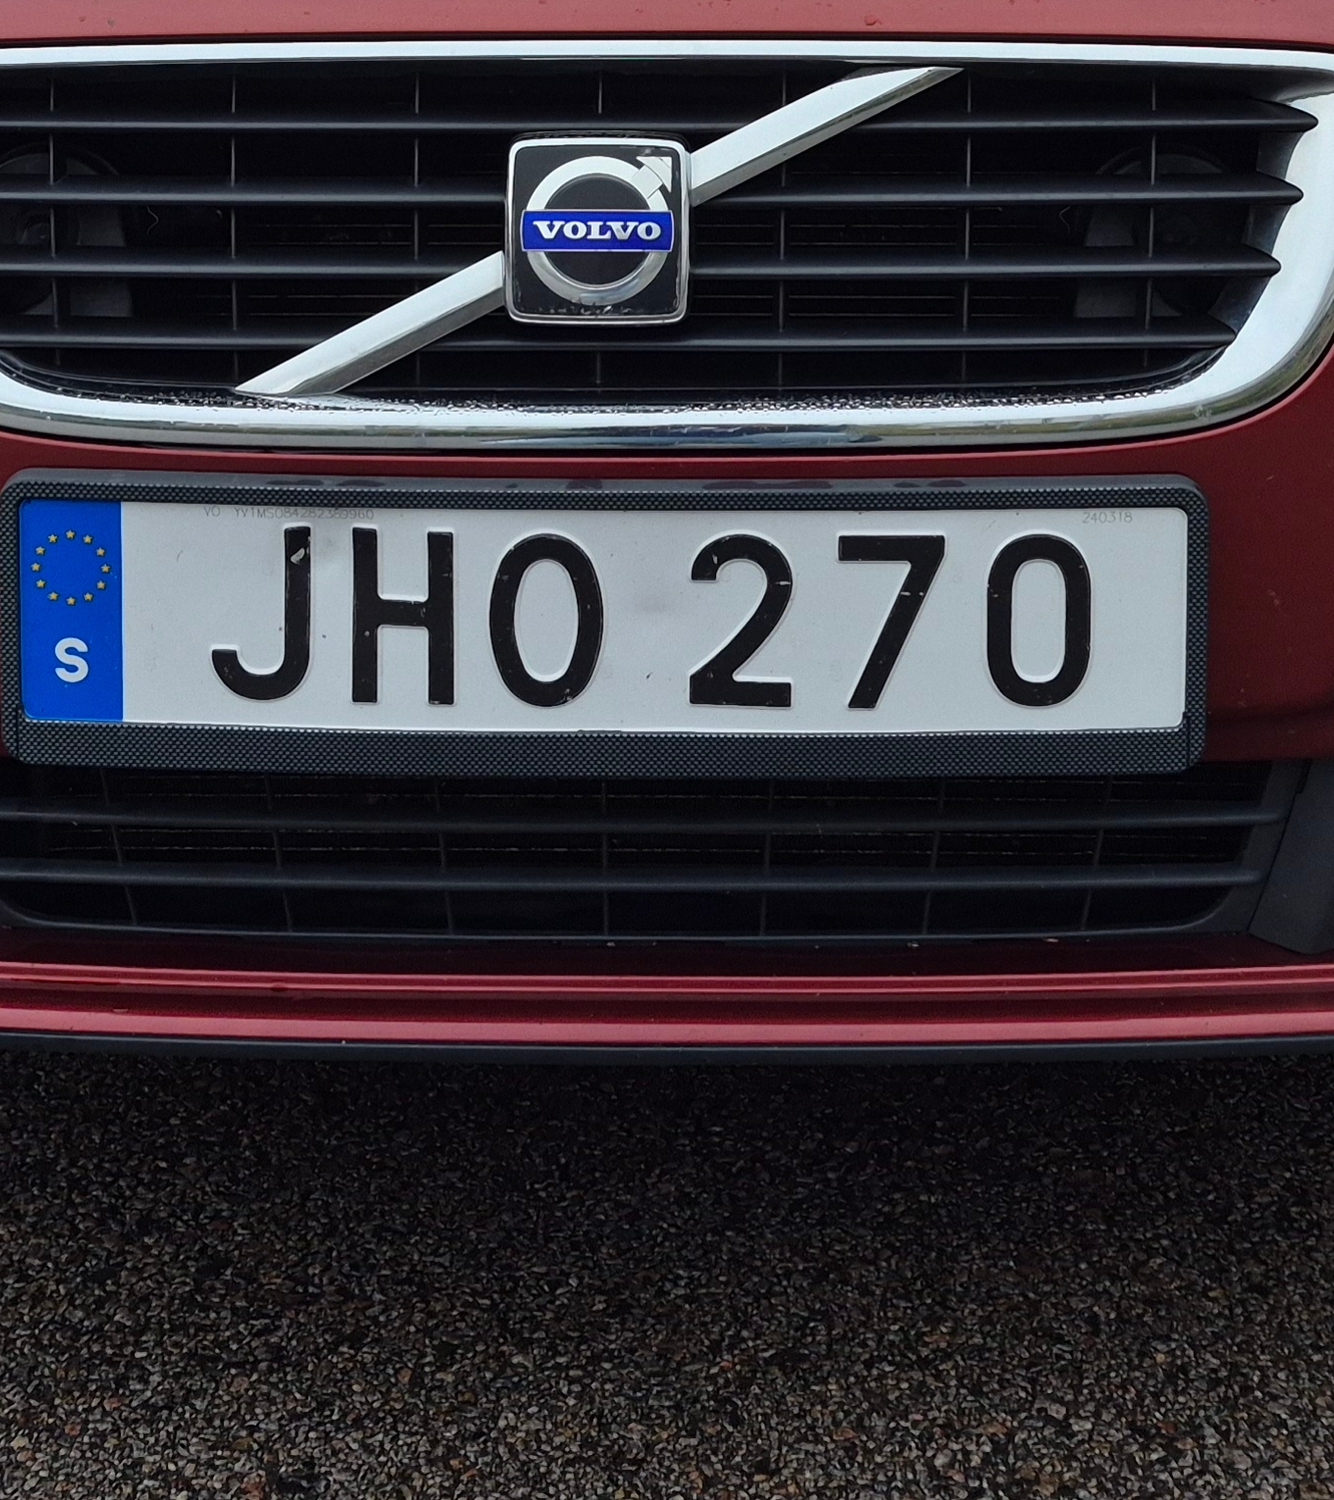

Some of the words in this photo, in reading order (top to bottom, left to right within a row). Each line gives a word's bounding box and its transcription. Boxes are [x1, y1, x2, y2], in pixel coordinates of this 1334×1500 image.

[533, 220, 661, 240] VOLVO
[1082, 511, 1133, 523] 240318
[211, 526, 604, 708] JHO
[689, 534, 1092, 709] 270
[55, 637, 89, 683] S
